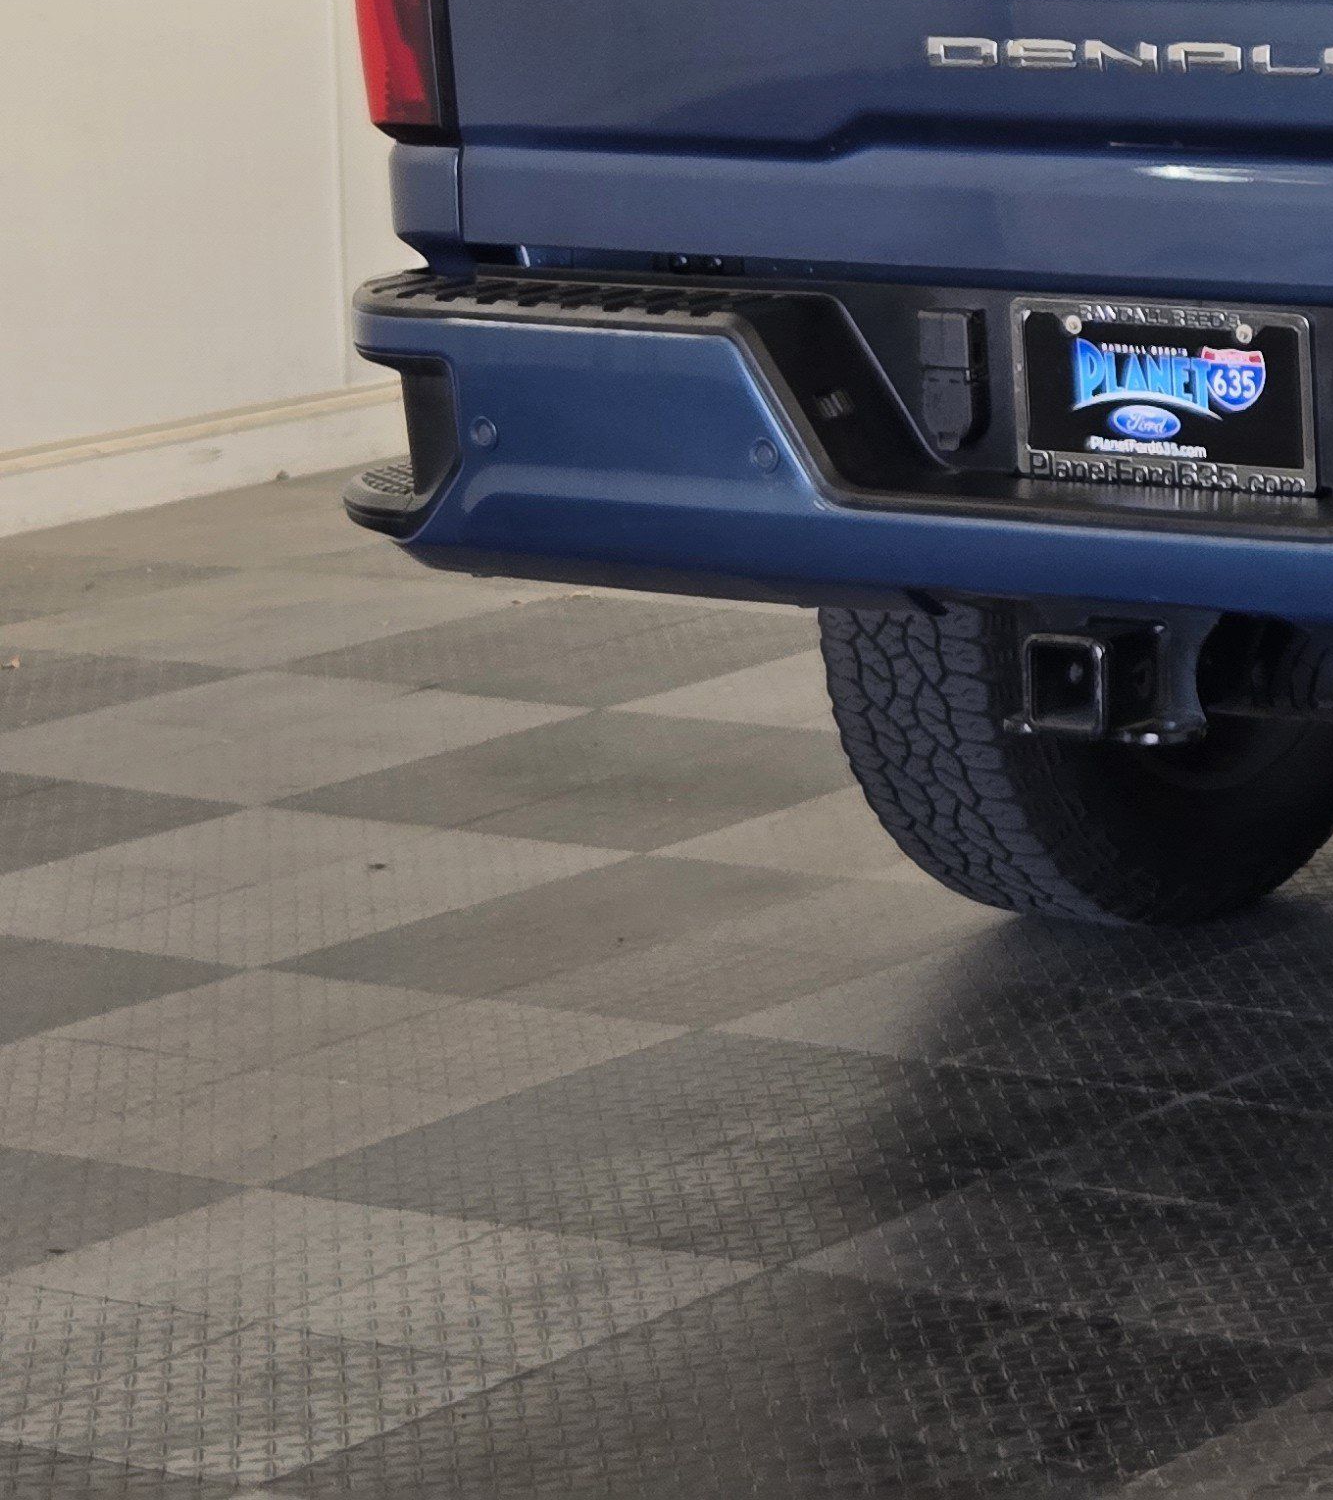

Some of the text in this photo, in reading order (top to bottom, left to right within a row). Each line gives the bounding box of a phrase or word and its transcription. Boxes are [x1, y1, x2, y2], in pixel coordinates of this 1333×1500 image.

[1079, 304, 1168, 324] RANDALL
[1075, 338, 1256, 411] PLANET 635
[1126, 413, 1167, 436] Ford
